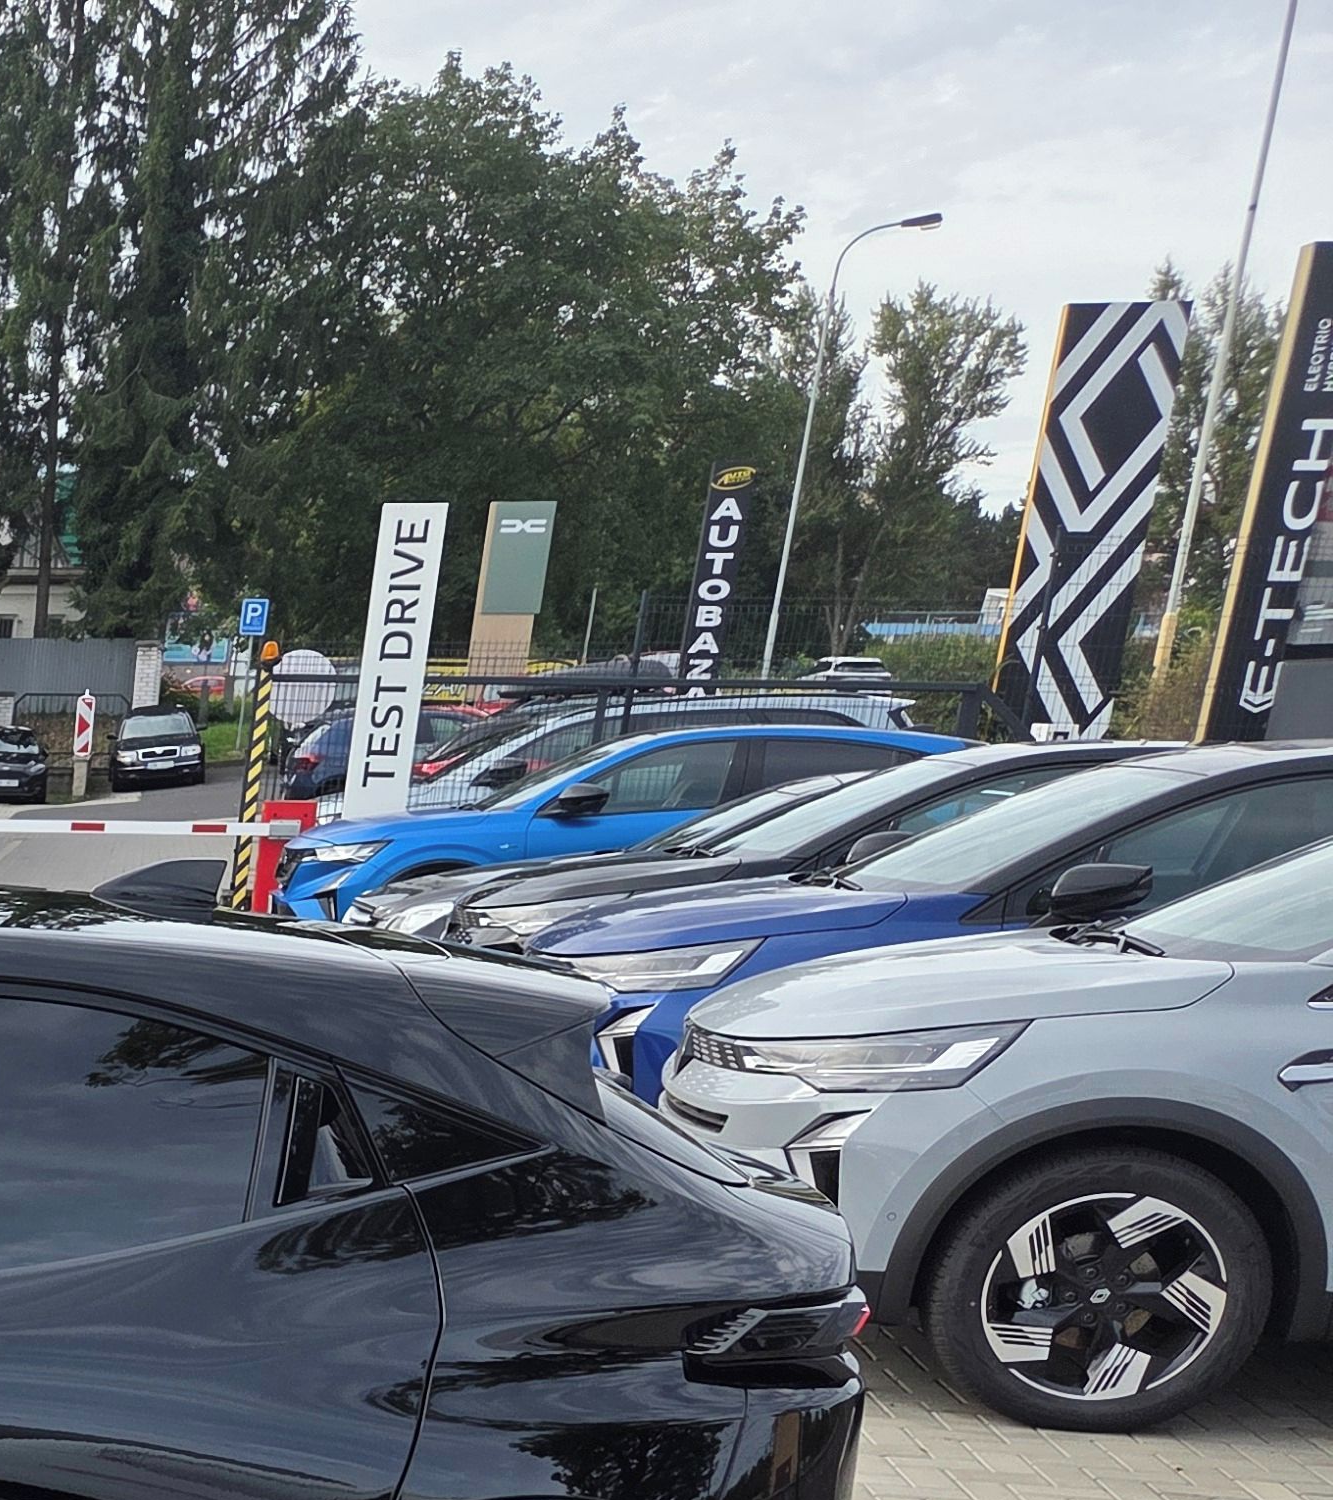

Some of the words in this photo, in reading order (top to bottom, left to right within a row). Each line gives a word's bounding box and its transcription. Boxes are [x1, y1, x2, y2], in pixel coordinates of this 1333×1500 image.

[245, 603, 263, 625] P
[379, 519, 430, 661] DRIVE
[1239, 418, 1333, 714] E-TECH
[362, 675, 407, 787] TEST
